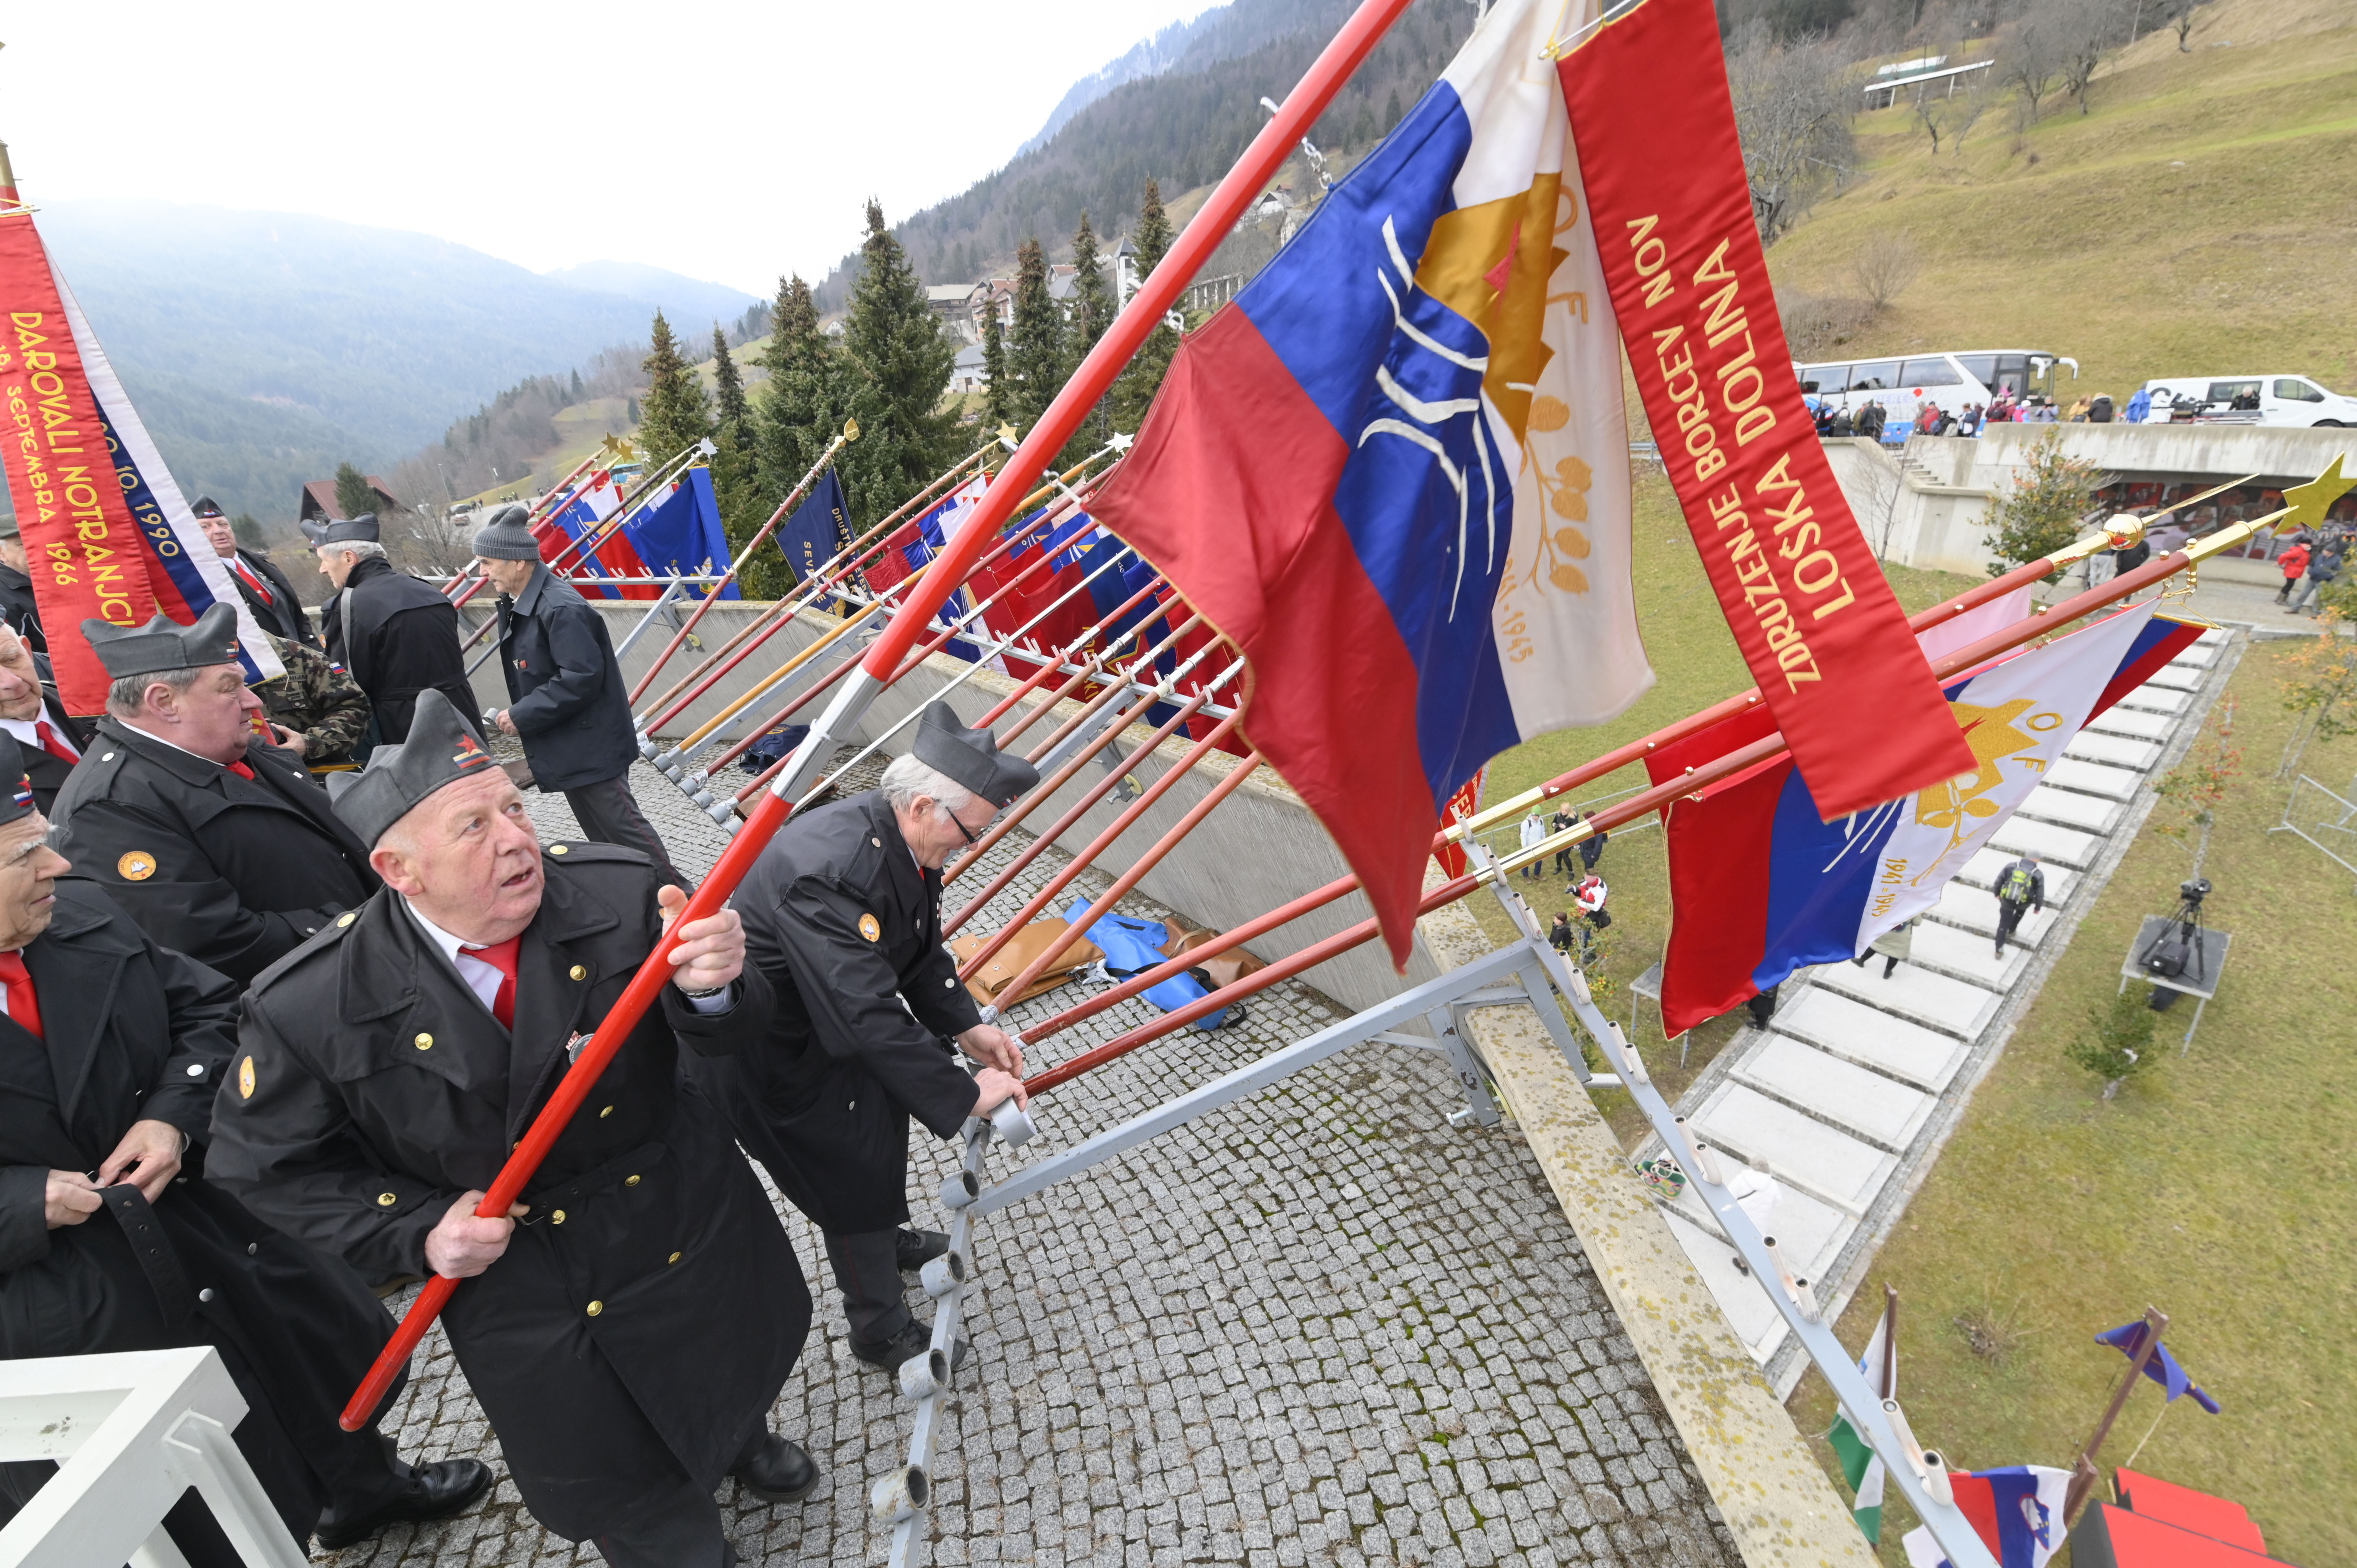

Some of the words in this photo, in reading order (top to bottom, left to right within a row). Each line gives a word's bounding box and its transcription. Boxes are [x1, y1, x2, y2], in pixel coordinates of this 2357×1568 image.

[1626, 214, 1675, 309] NOV
[1693, 237, 1777, 447] DOLINA
[7, 386, 57, 523] SEPTEMBRA
[46, 541, 78, 585] 1966
[11, 312, 84, 453] DAROVALI
[58, 466, 136, 625] NOTRANJCI
[1652, 325, 1727, 482] BORCEV
[116, 466, 138, 494] 10.
[134, 502, 179, 557] 1990
[1707, 481, 1822, 694] ZDRUŽENJE
[1755, 452, 1856, 621] LOŠKA
